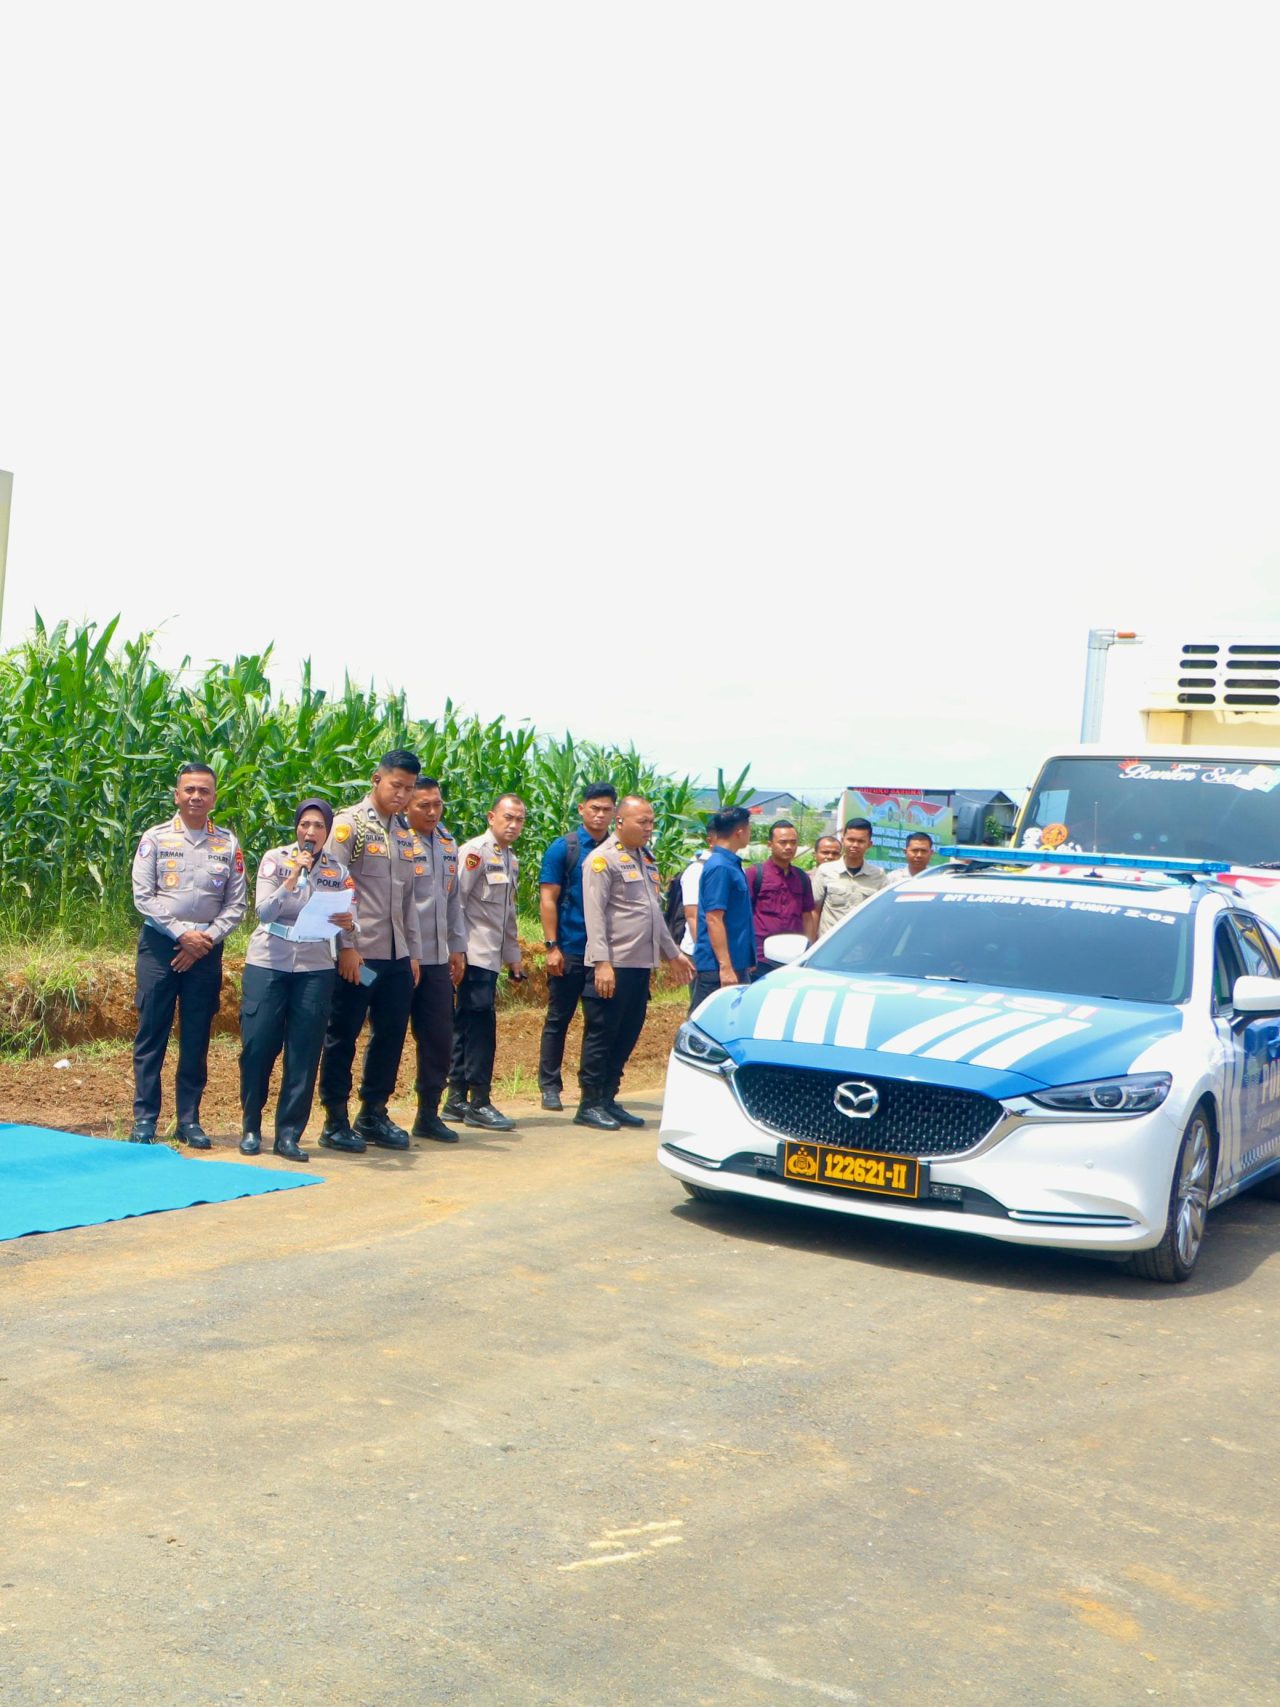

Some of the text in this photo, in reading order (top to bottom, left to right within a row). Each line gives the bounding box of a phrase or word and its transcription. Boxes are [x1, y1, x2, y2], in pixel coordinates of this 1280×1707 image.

[160, 850, 184, 858] FIRMAN
[208, 854, 229, 862] POLRI
[317, 878, 340, 888] POLRI
[784, 976, 1100, 1021] POLISI
[824, 1153, 908, 1190] 122621-II
